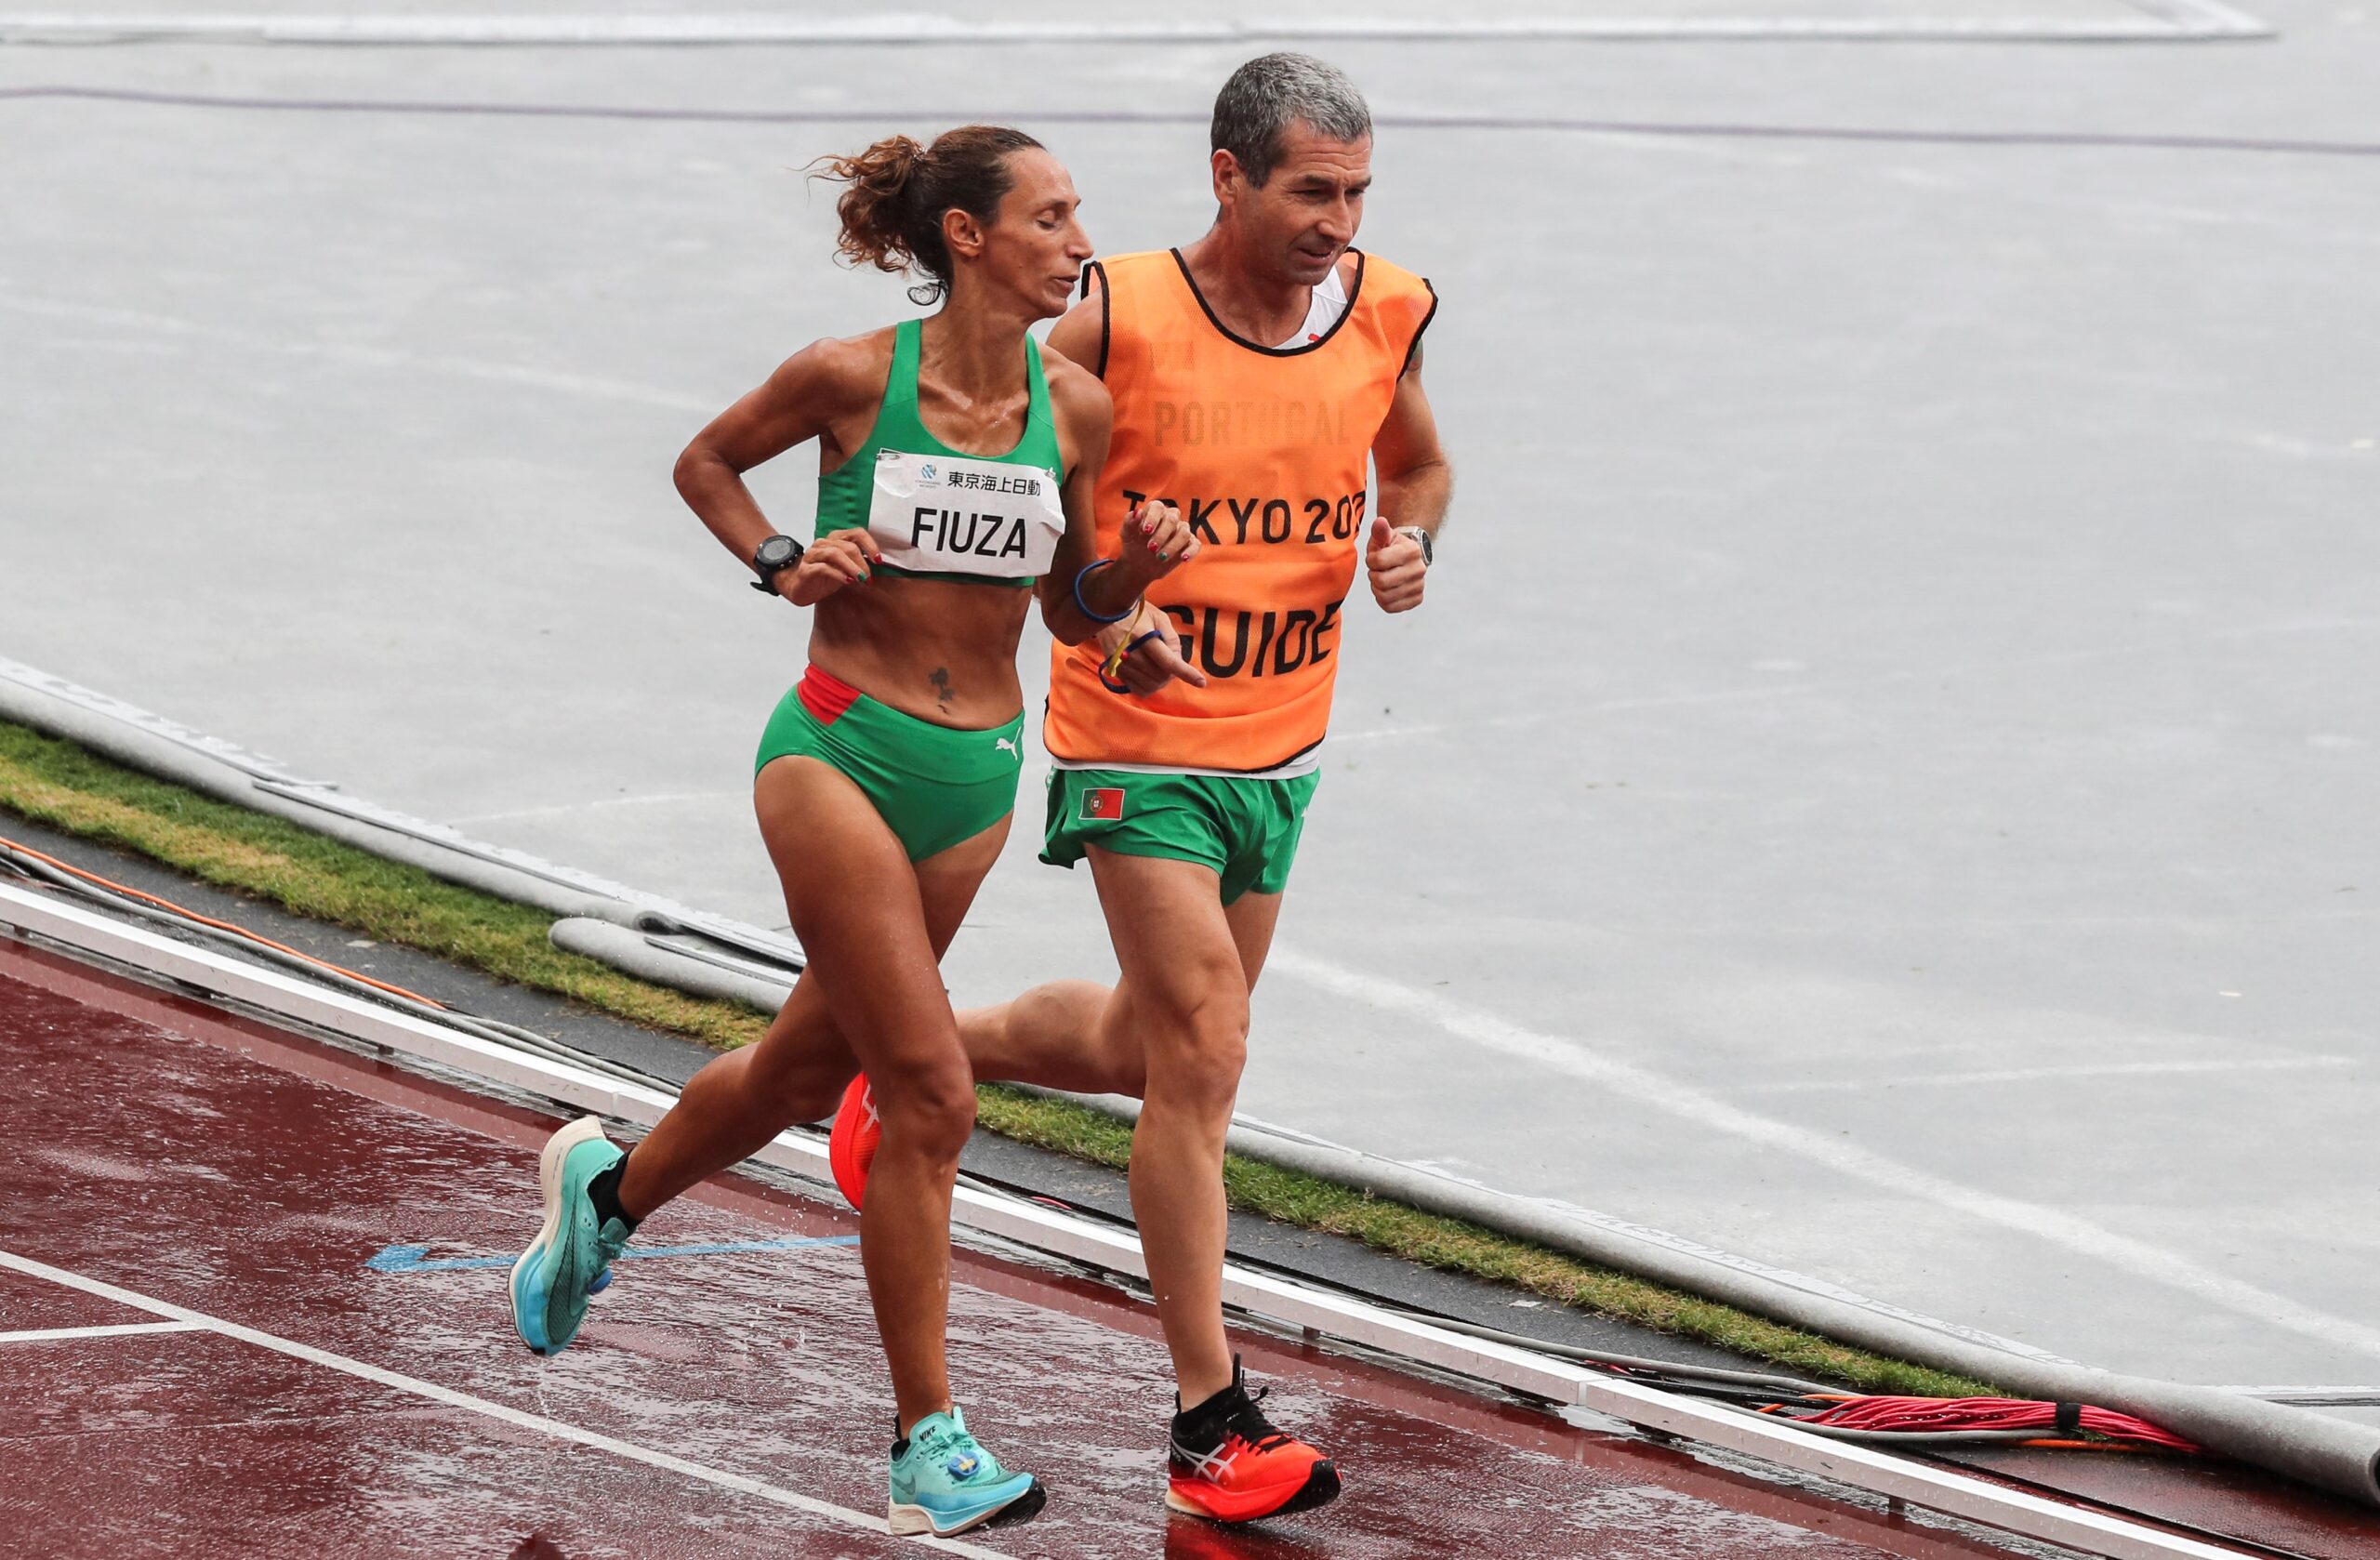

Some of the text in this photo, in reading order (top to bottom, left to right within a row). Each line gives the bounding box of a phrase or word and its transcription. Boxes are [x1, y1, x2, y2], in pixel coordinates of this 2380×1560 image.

[1155, 401, 1352, 447] PORTUGAL
[947, 471, 1041, 496] 東京海上日動
[911, 507, 1026, 559] FIUZA
[1122, 490, 1291, 546] TKYO
